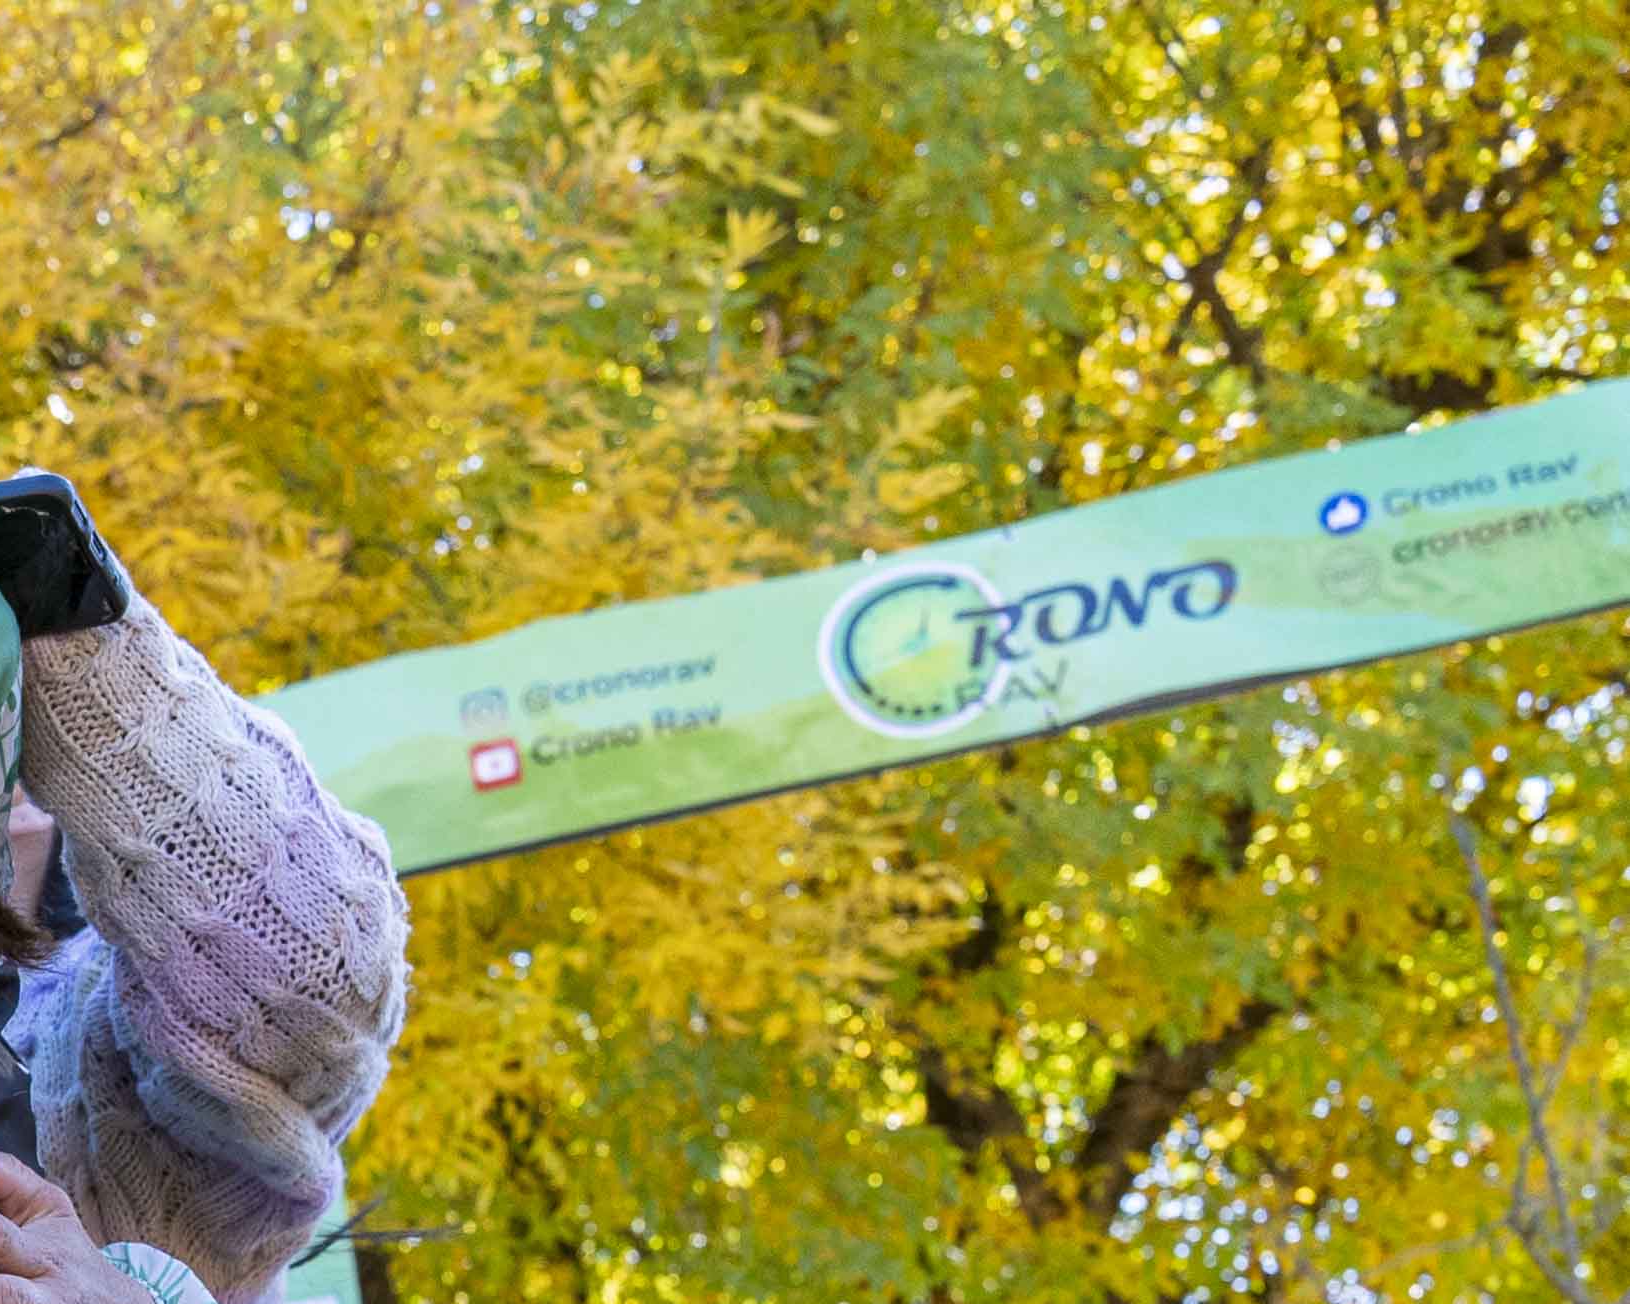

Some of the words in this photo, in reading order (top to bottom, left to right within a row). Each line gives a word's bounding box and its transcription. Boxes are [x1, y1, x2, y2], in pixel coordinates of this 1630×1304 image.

[1382, 472, 1498, 517] Crono
[1507, 452, 1579, 487] Rav
[521, 655, 717, 717] @cronorav
[529, 721, 643, 766] Crono
[650, 704, 722, 733] Rav
